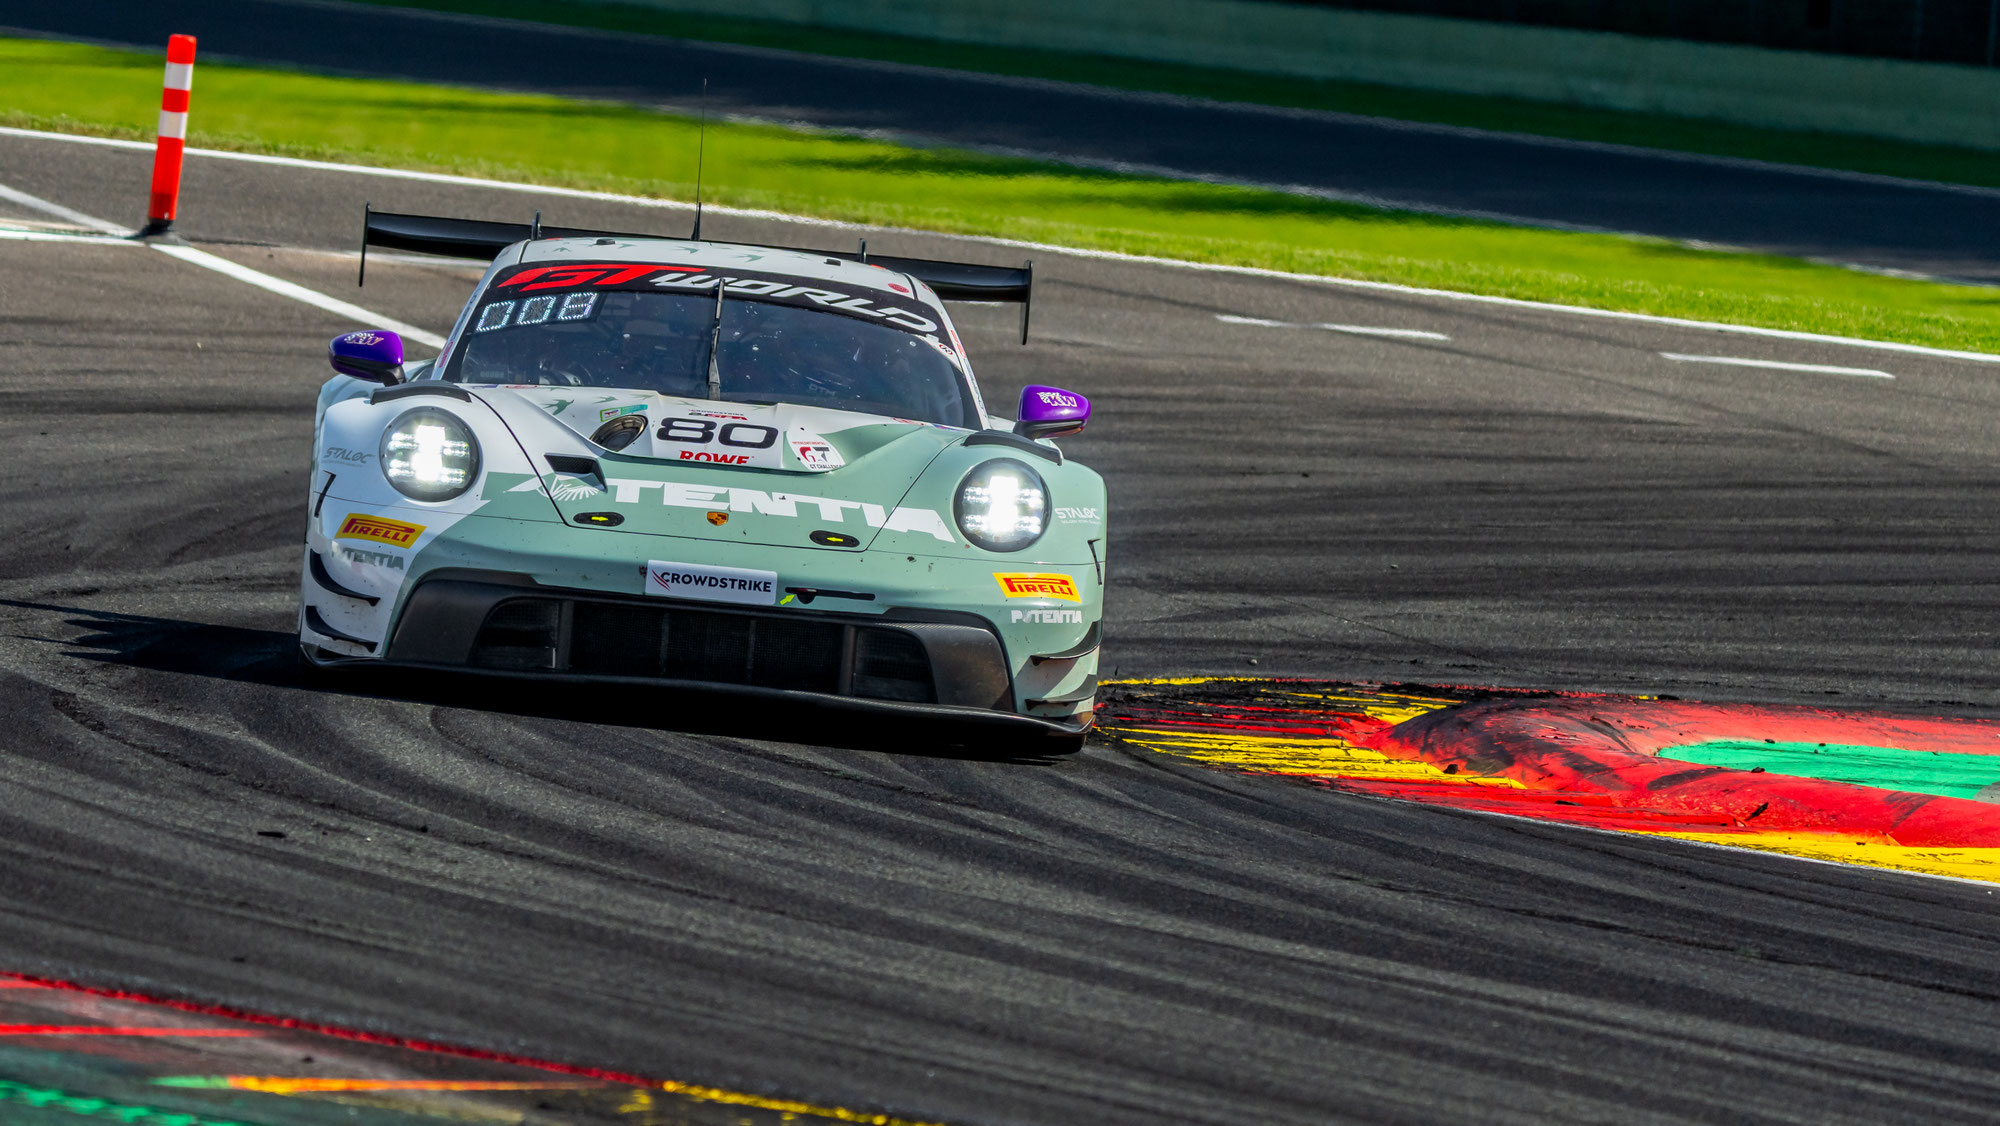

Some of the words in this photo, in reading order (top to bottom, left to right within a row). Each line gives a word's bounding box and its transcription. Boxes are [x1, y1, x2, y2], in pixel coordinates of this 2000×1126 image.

[497, 264, 707, 292] GT
[649, 272, 938, 333] WORLD
[656, 417, 778, 449] 80
[324, 447, 375, 464] STALOC
[1055, 507, 1100, 520] STALOC
[343, 518, 416, 543] PIRELLI
[660, 572, 772, 593] CROWDSTRIKE
[1003, 577, 1074, 596] PIRELLI
